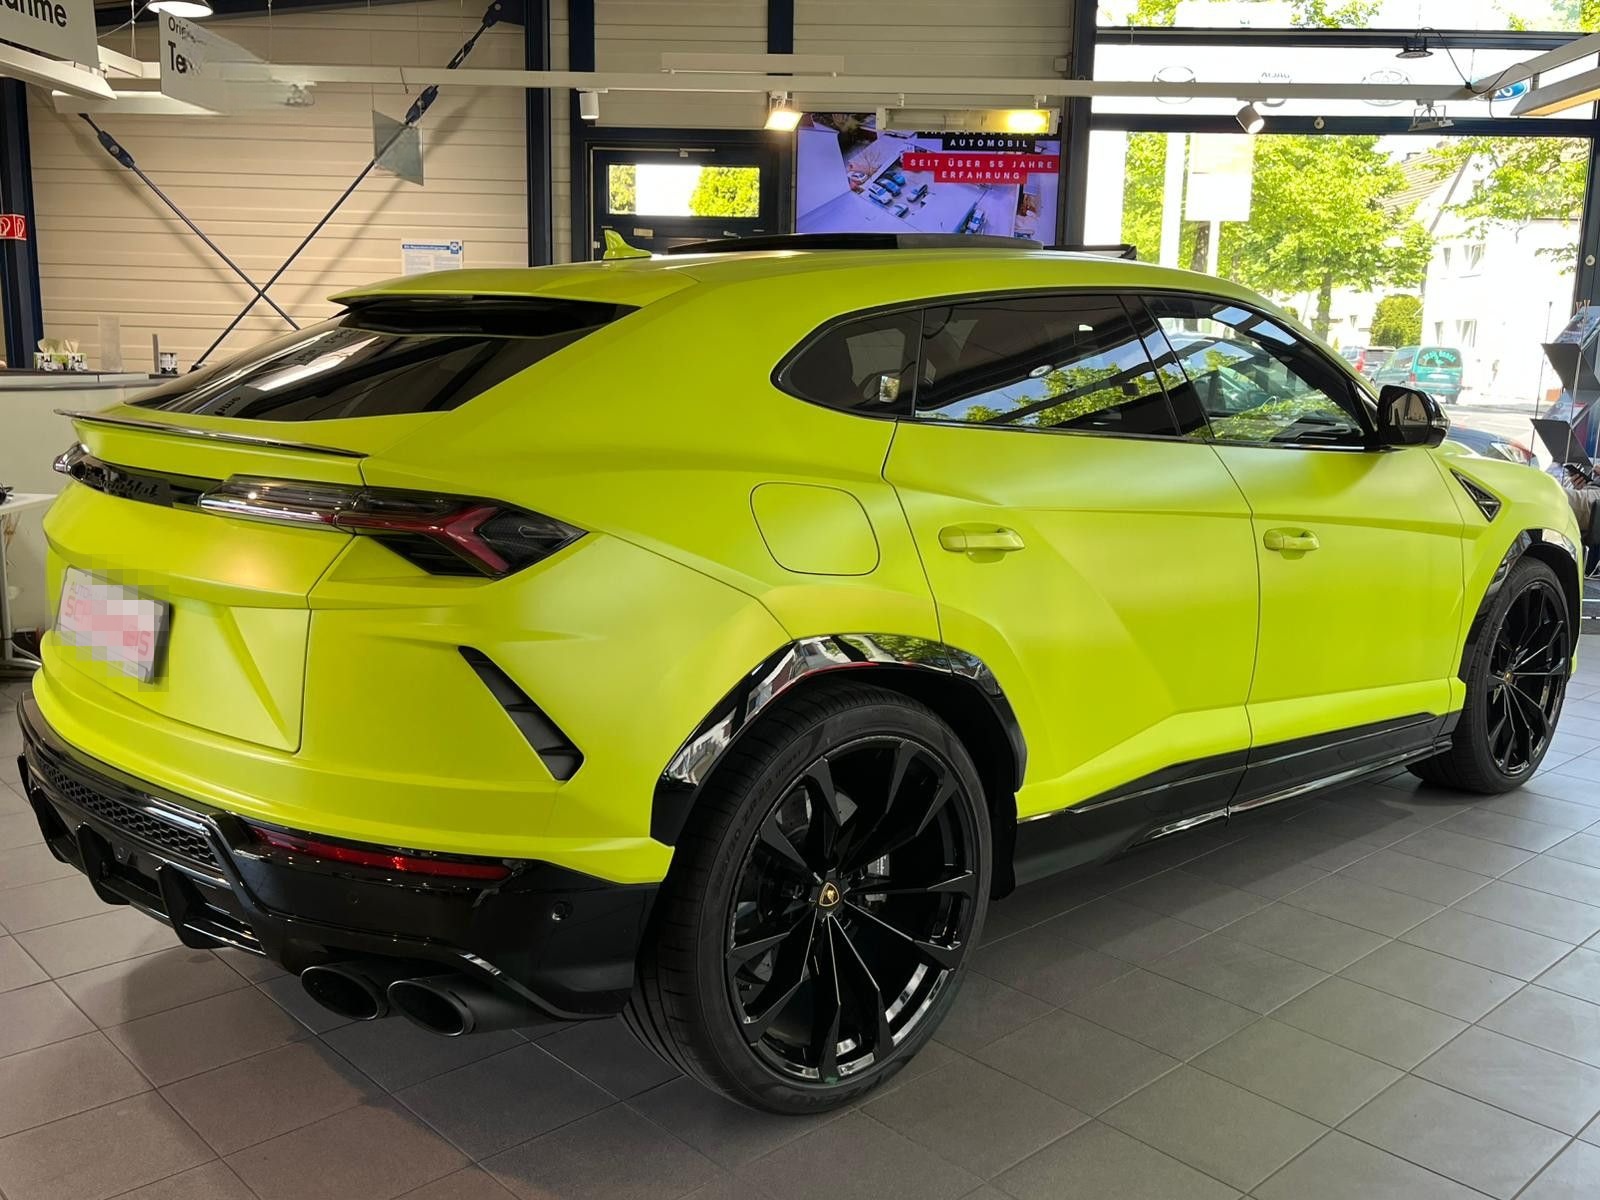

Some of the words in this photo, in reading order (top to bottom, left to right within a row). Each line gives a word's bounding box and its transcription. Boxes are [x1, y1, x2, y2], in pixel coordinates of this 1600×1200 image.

[950, 139, 1028, 148] AUTOMOBIL
[910, 159, 939, 167] SEIT
[948, 158, 980, 168] ÜBER
[1012, 160, 1053, 169] JAHRE
[941, 170, 1020, 180] ERFAHRUNG
